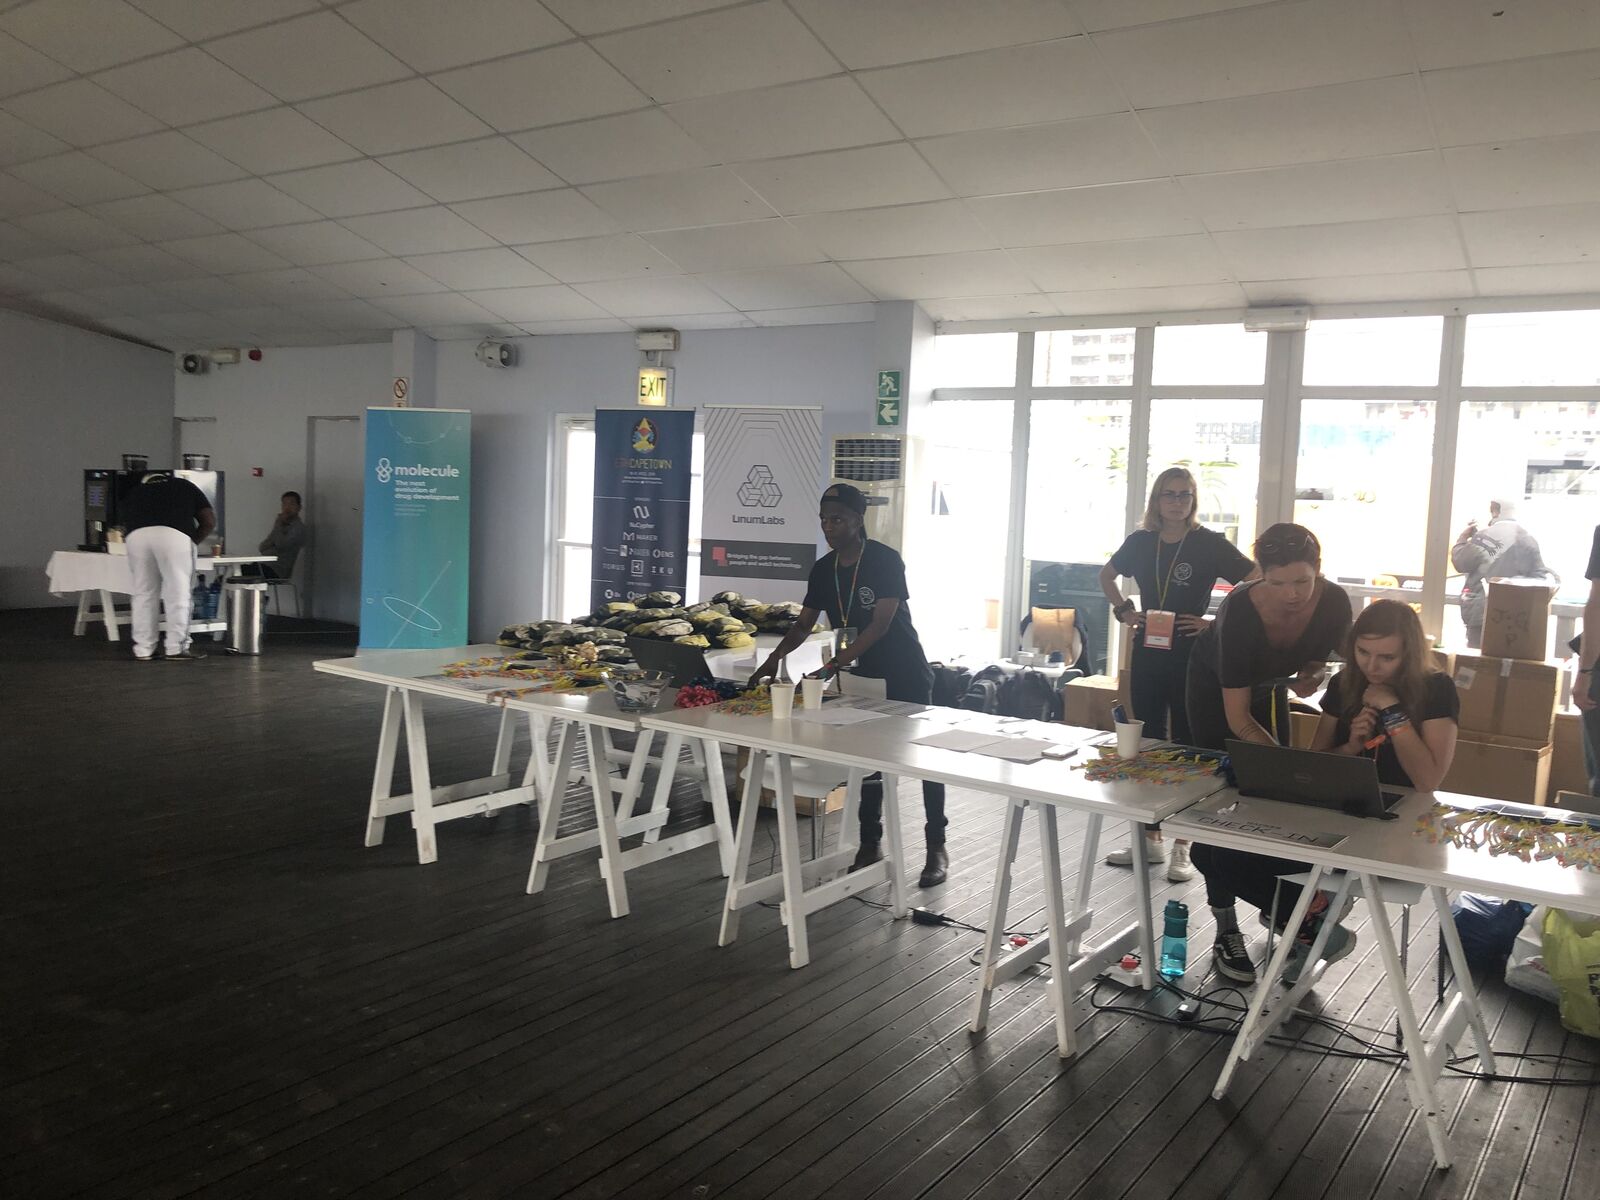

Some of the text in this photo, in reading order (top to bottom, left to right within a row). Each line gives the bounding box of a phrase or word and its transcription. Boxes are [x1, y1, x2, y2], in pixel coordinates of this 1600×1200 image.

[640, 377, 666, 397] EXIT
[395, 463, 460, 477] molecule
[732, 514, 785, 525] LinumLabs
[1198, 816, 1319, 843] CHECK-IN
